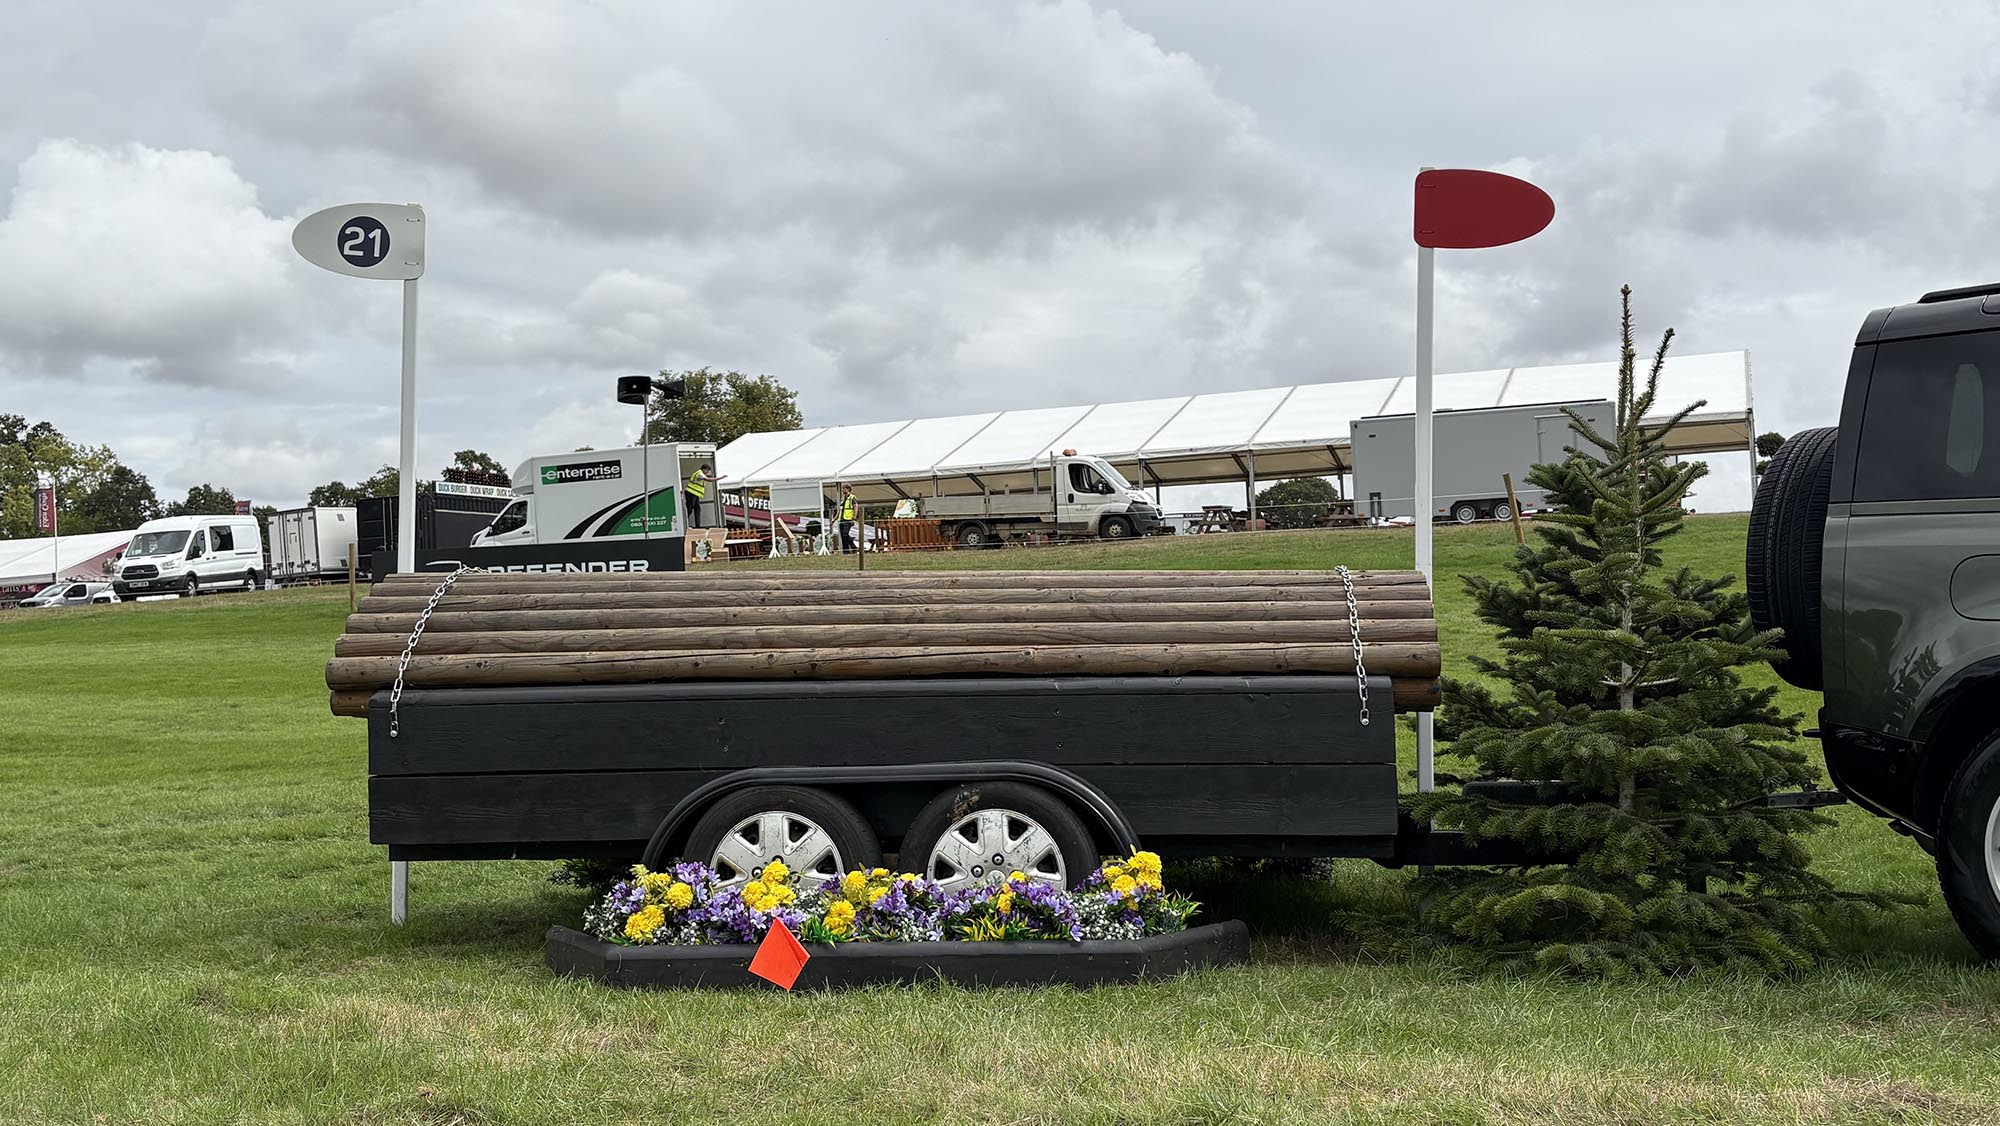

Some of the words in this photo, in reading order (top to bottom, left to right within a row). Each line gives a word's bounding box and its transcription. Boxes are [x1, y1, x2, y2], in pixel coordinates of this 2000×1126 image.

[343, 226, 382, 258] 21
[545, 464, 620, 480] enterprise
[438, 483, 450, 492] DUCK
[450, 484, 468, 494] BURGER
[470, 486, 481, 495] DUCK
[482, 487, 494, 496] WRAP
[496, 488, 508, 497] DUCK
[721, 492, 741, 507] OSTA
[741, 495, 771, 511] OFFEE
